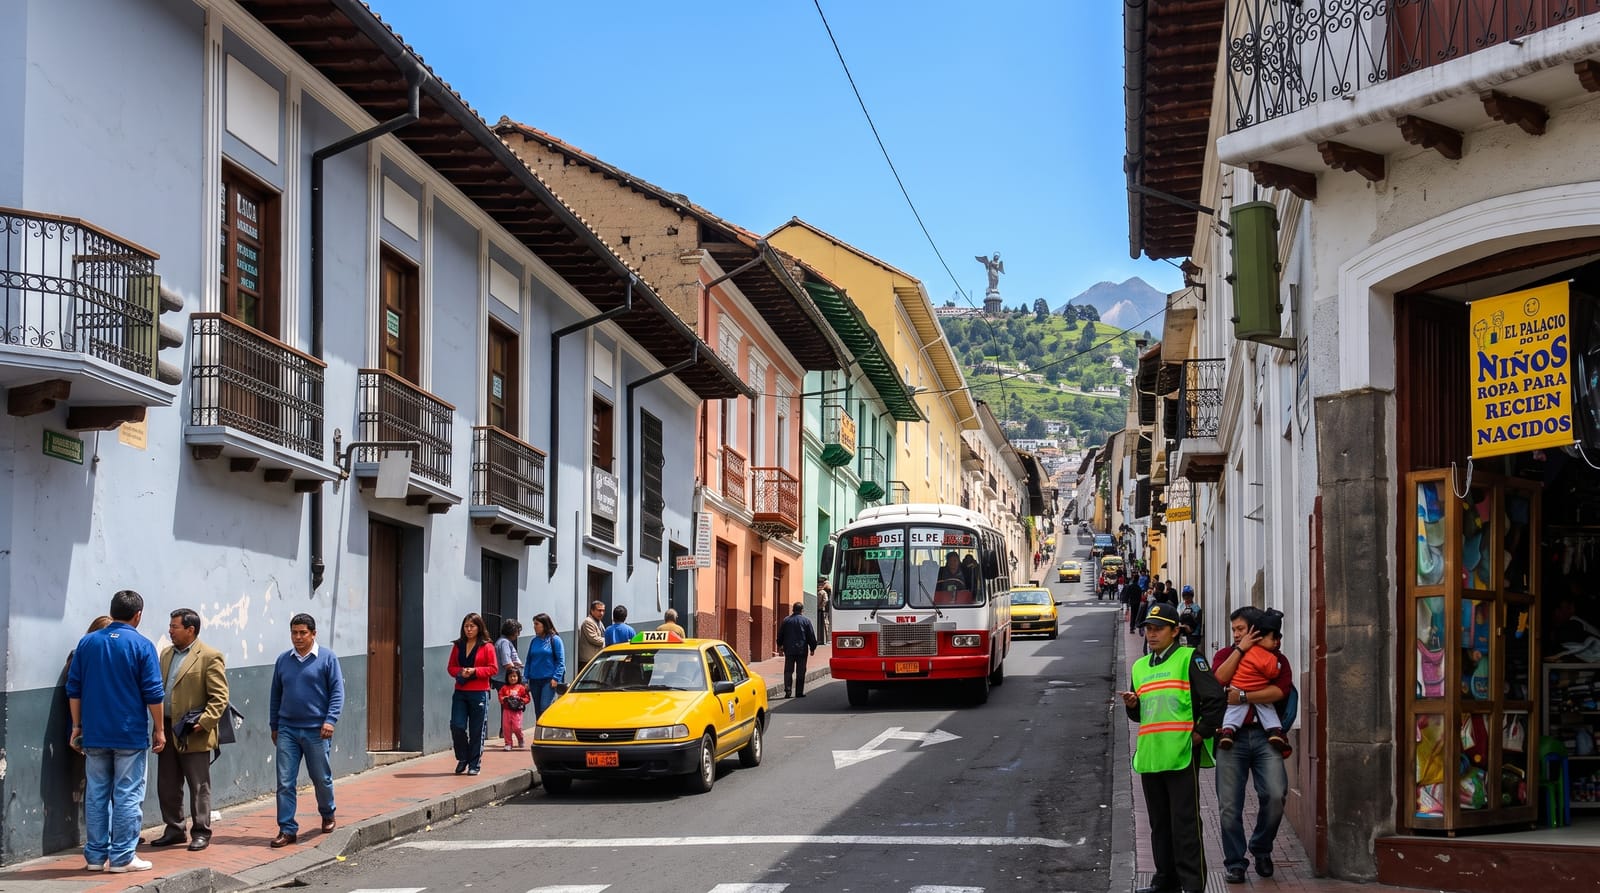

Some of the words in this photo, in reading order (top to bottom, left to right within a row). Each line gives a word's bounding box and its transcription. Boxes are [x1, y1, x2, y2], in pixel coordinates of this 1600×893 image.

[1504, 325, 1517, 339] EL
[1520, 314, 1566, 338] PALACIO
[1477, 334, 1568, 382] NIÑOS
[1477, 381, 1519, 400] ROPA
[1523, 372, 1567, 392] PARA
[1485, 391, 1561, 420] RECIEN
[1477, 415, 1571, 445] NACIDOS
[644, 632, 667, 641] TAXI
